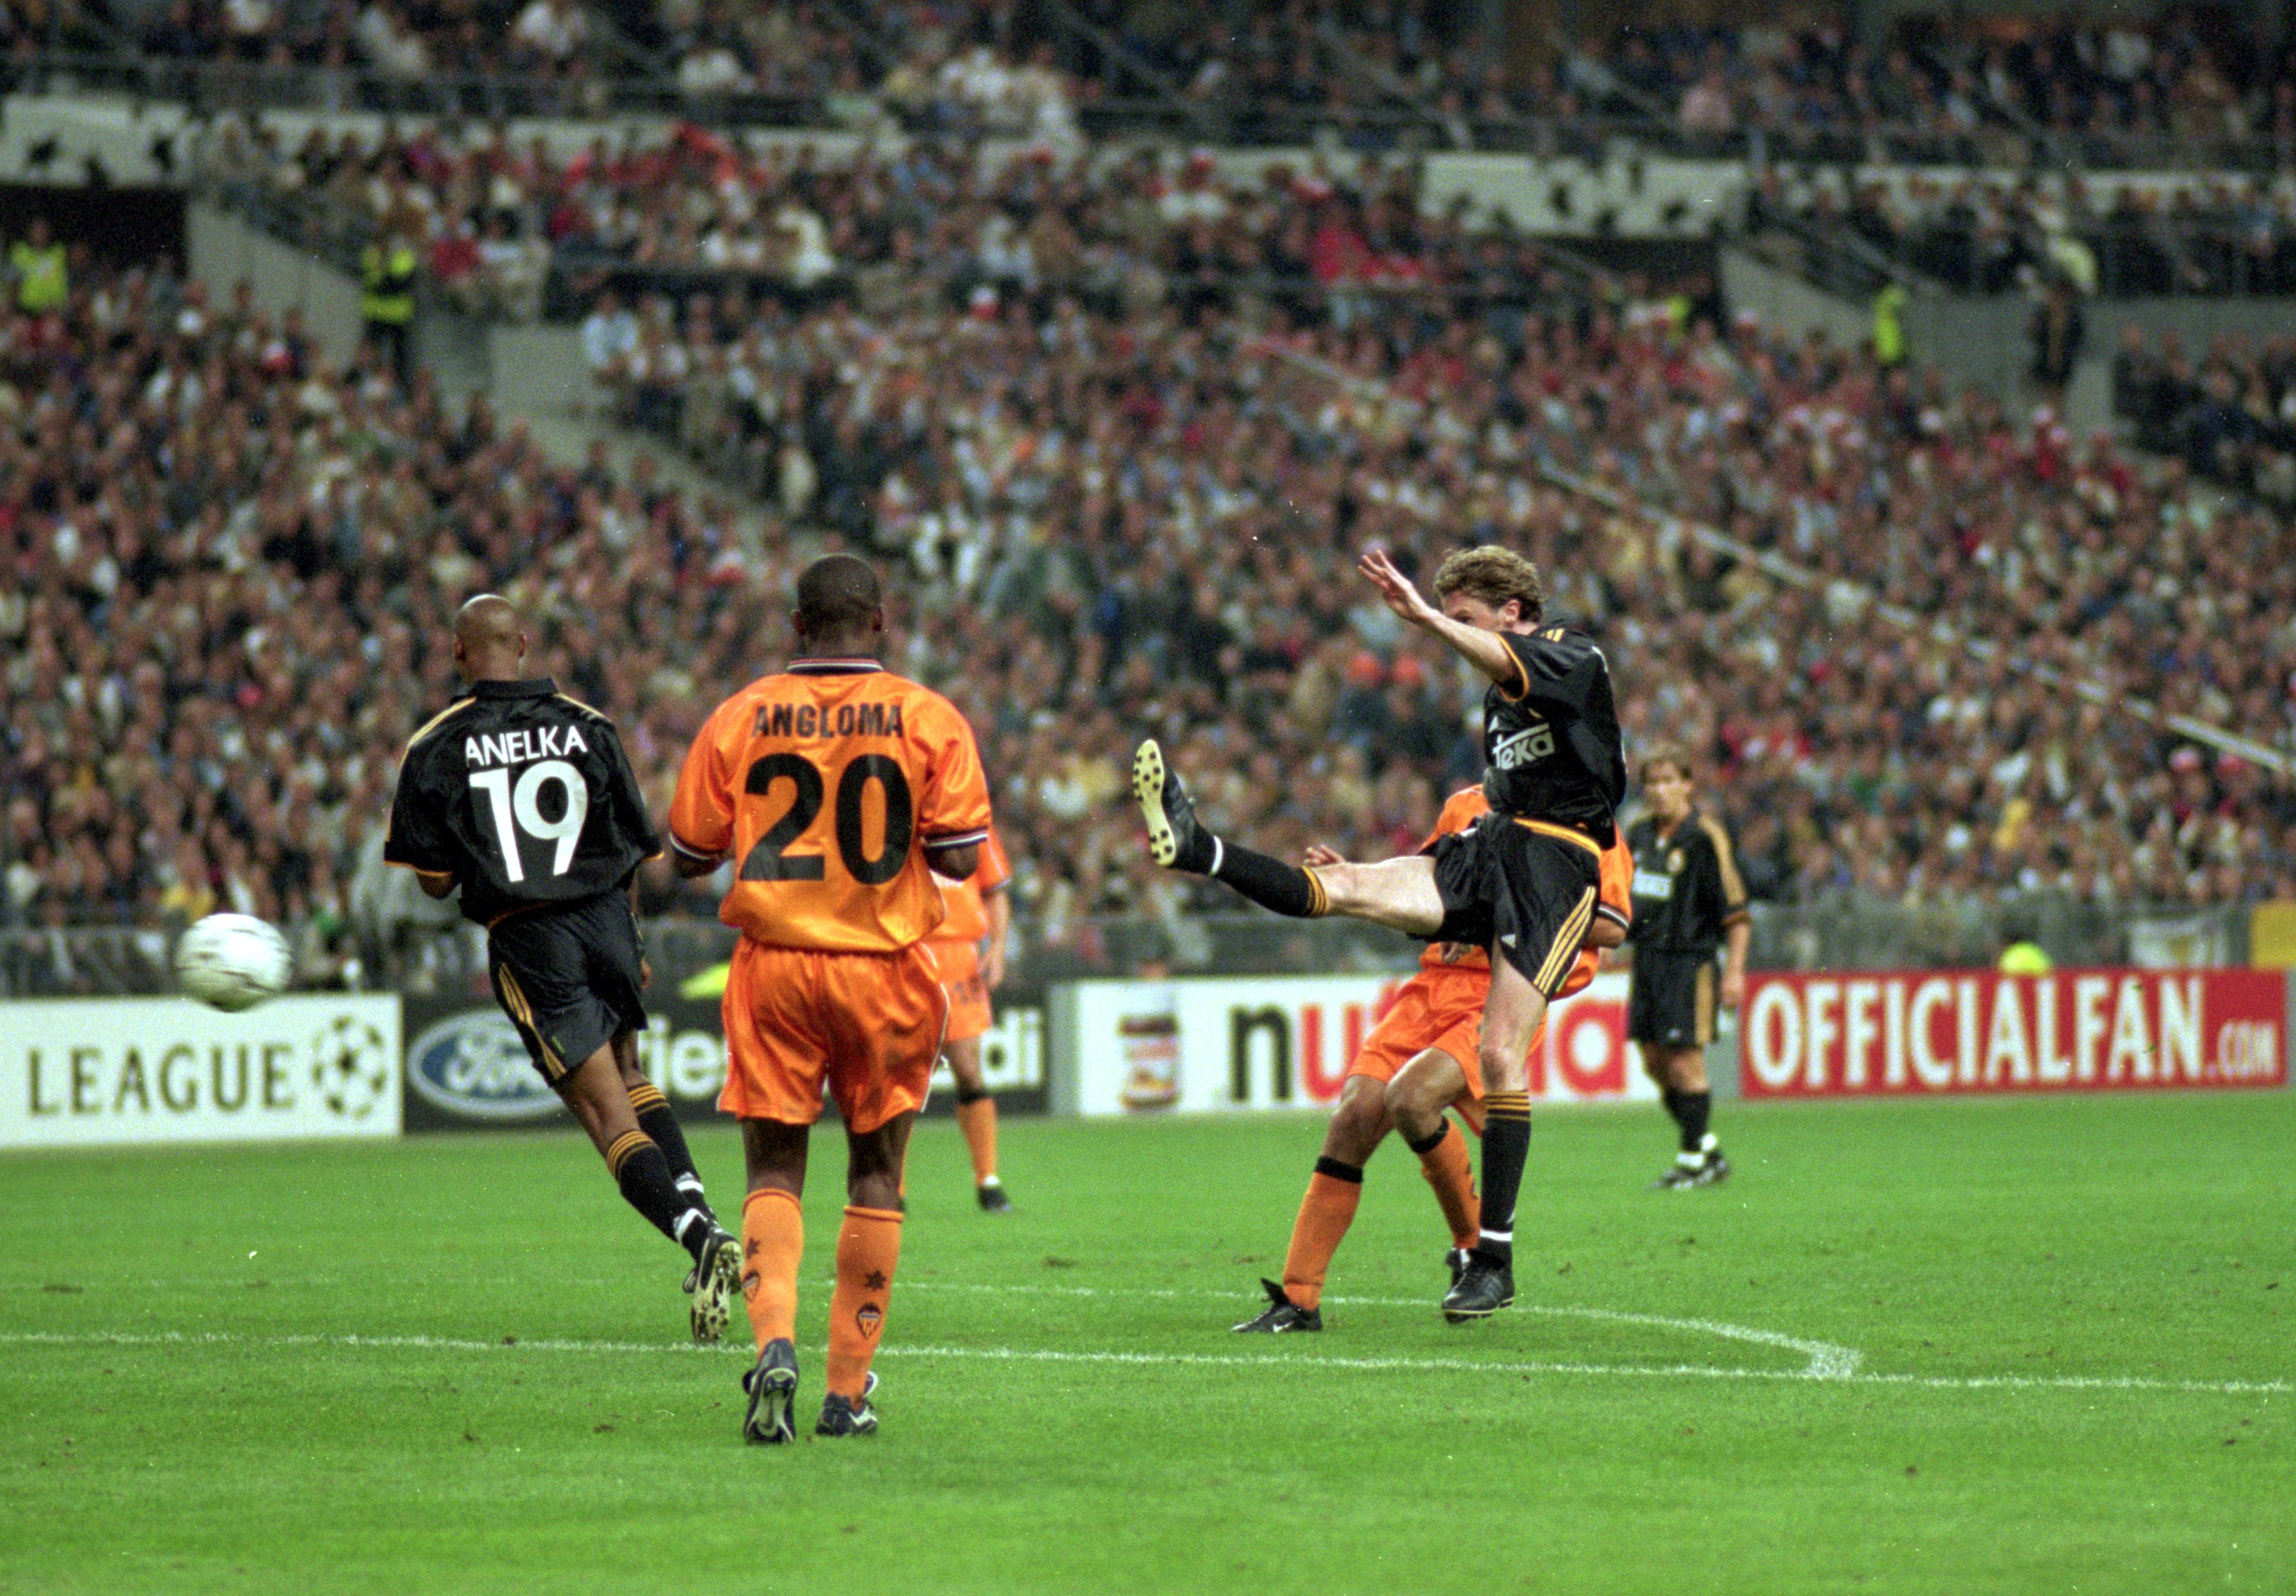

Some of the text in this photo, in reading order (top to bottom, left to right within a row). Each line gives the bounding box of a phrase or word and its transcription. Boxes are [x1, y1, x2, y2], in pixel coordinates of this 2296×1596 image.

[466, 725, 588, 768] ANELKA
[752, 703, 904, 738] ANGLOMA
[469, 760, 588, 882] 19
[740, 752, 912, 885] 20
[28, 1043, 296, 1116] LEAGUE
